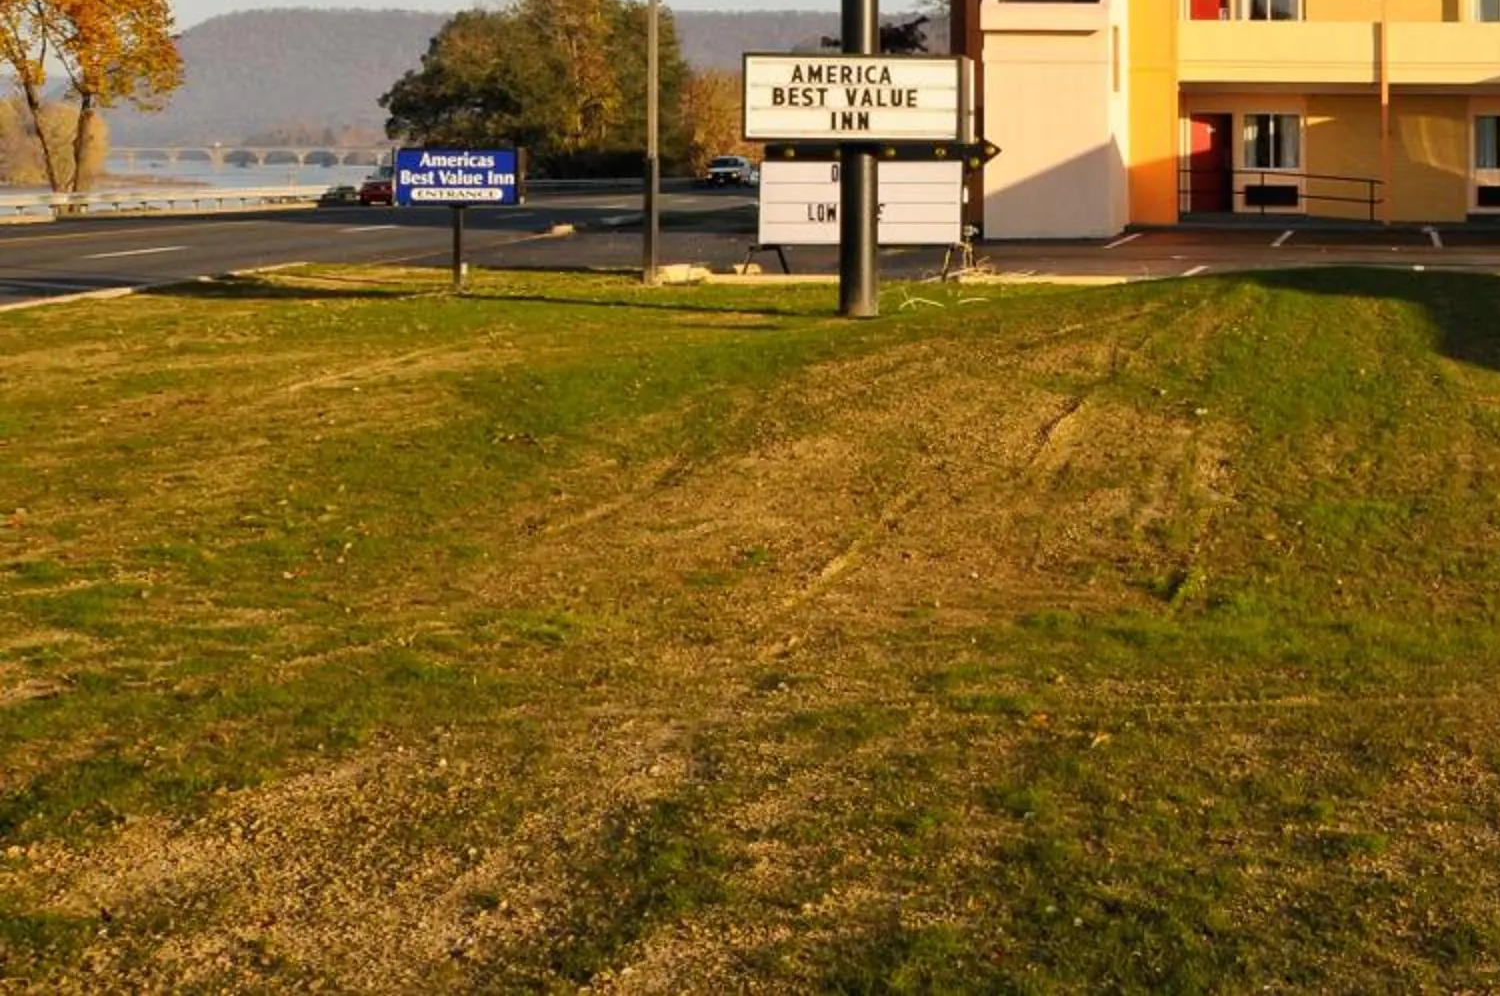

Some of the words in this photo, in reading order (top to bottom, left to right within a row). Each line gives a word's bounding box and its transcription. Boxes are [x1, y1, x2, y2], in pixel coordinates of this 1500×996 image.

[791, 64, 892, 85] AMERICA
[772, 87, 829, 107] BEST
[845, 87, 918, 108] VALUE
[831, 111, 870, 131] INN
[419, 151, 495, 168] Americas
[399, 169, 435, 186] Best
[438, 169, 484, 186] Value
[487, 169, 515, 186] Inn
[416, 189, 498, 199] ENTRANCE
[807, 203, 837, 223] LOW
